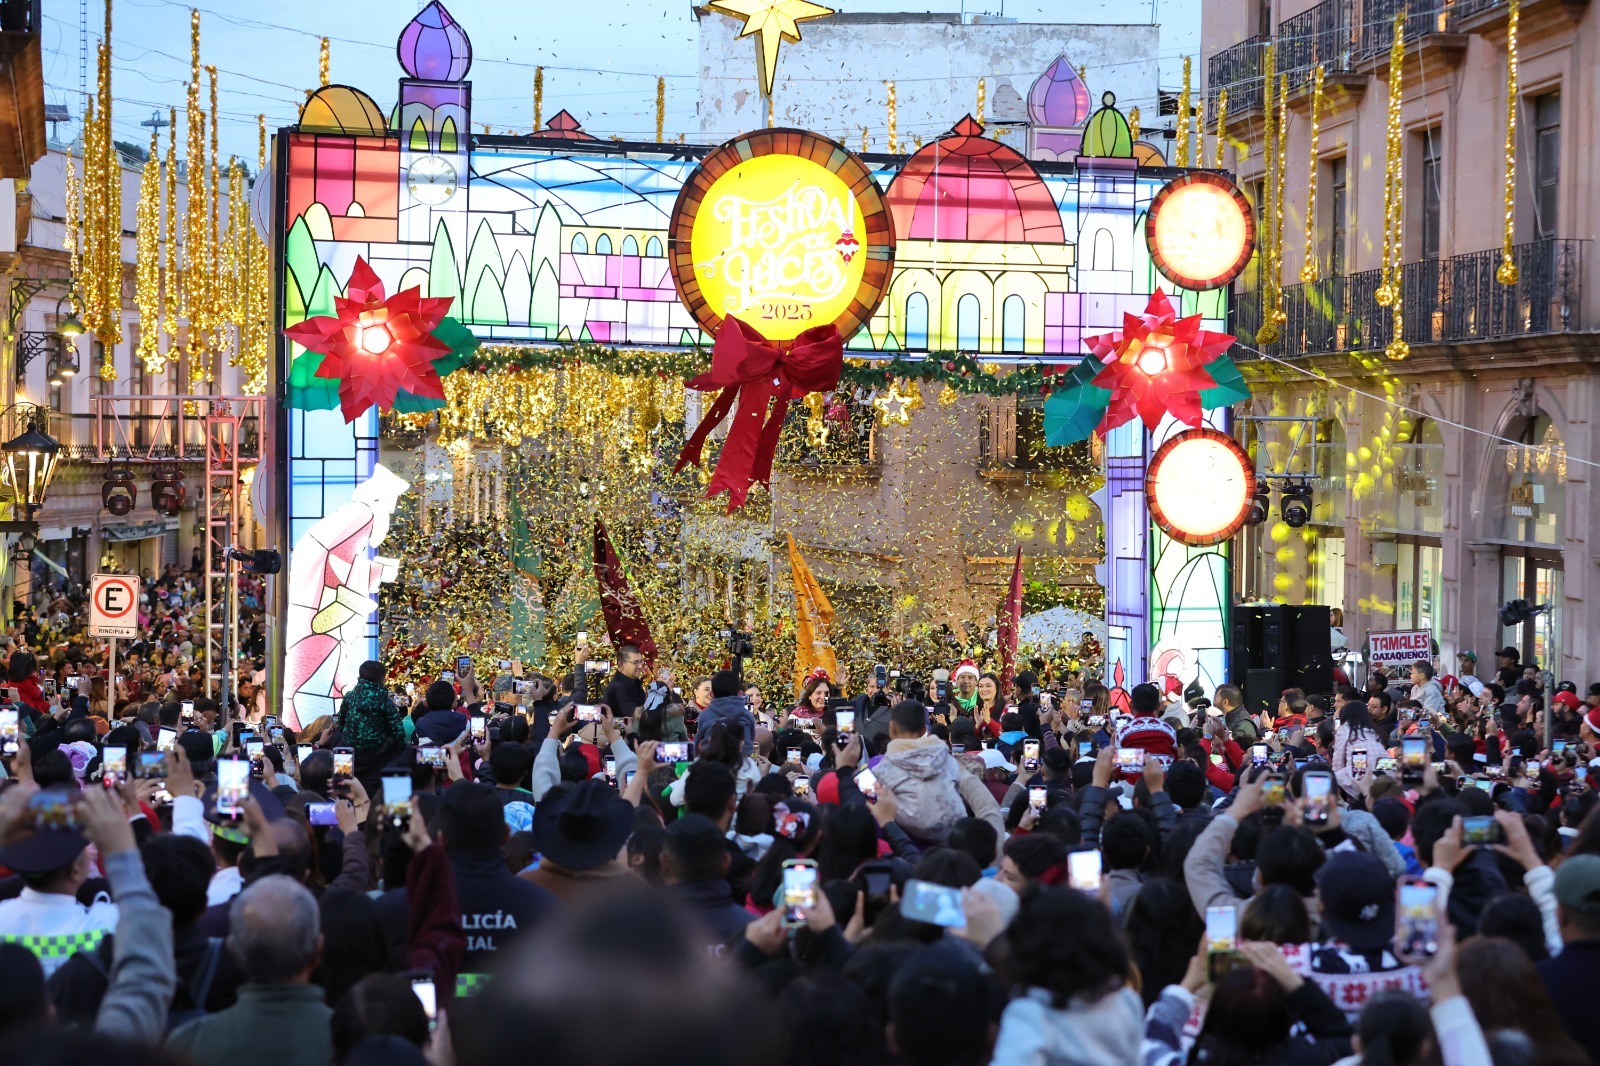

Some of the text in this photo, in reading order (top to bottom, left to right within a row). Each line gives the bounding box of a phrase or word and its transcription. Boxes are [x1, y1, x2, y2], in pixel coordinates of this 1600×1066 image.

[803, 231, 832, 250] DE
[723, 247, 847, 312] LUCES
[761, 303, 813, 321] 2025
[105, 587, 123, 611] E
[1371, 634, 1428, 651] TAMALES
[1372, 649, 1429, 661] OAXAQUEÑOS
[461, 909, 517, 929] LICÍA
[466, 936, 497, 951] IAL
